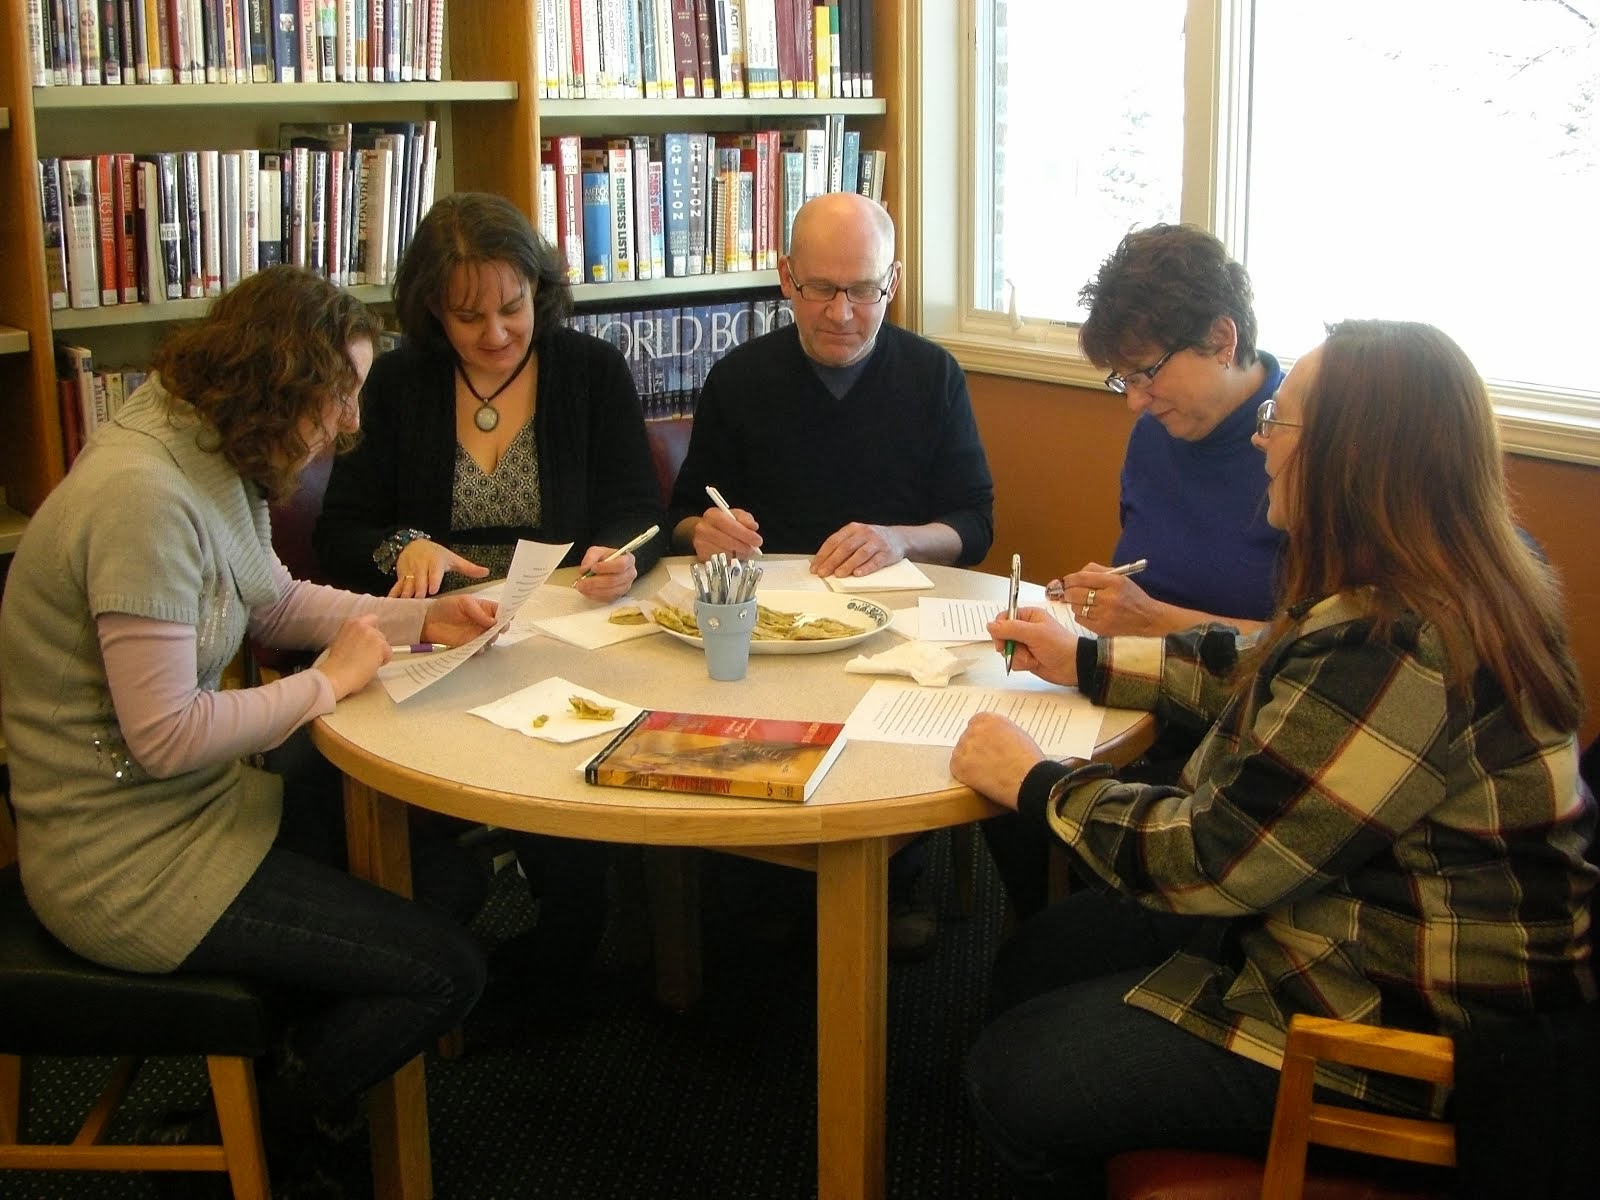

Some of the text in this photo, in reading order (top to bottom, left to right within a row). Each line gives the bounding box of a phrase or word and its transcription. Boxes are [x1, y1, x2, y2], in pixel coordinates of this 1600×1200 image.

[608, 10, 616, 51] CUSTODY
[123, 183, 133, 212] KENNEDY
[359, 175, 369, 235] TRIANGLE
[671, 144, 684, 221] CHILTON
[690, 142, 703, 218] CHILTON
[101, 191, 114, 244] IKE'S BLUFF
[616, 177, 628, 260] BUSINESS LISTS
[574, 308, 794, 361] ORLD BOO
